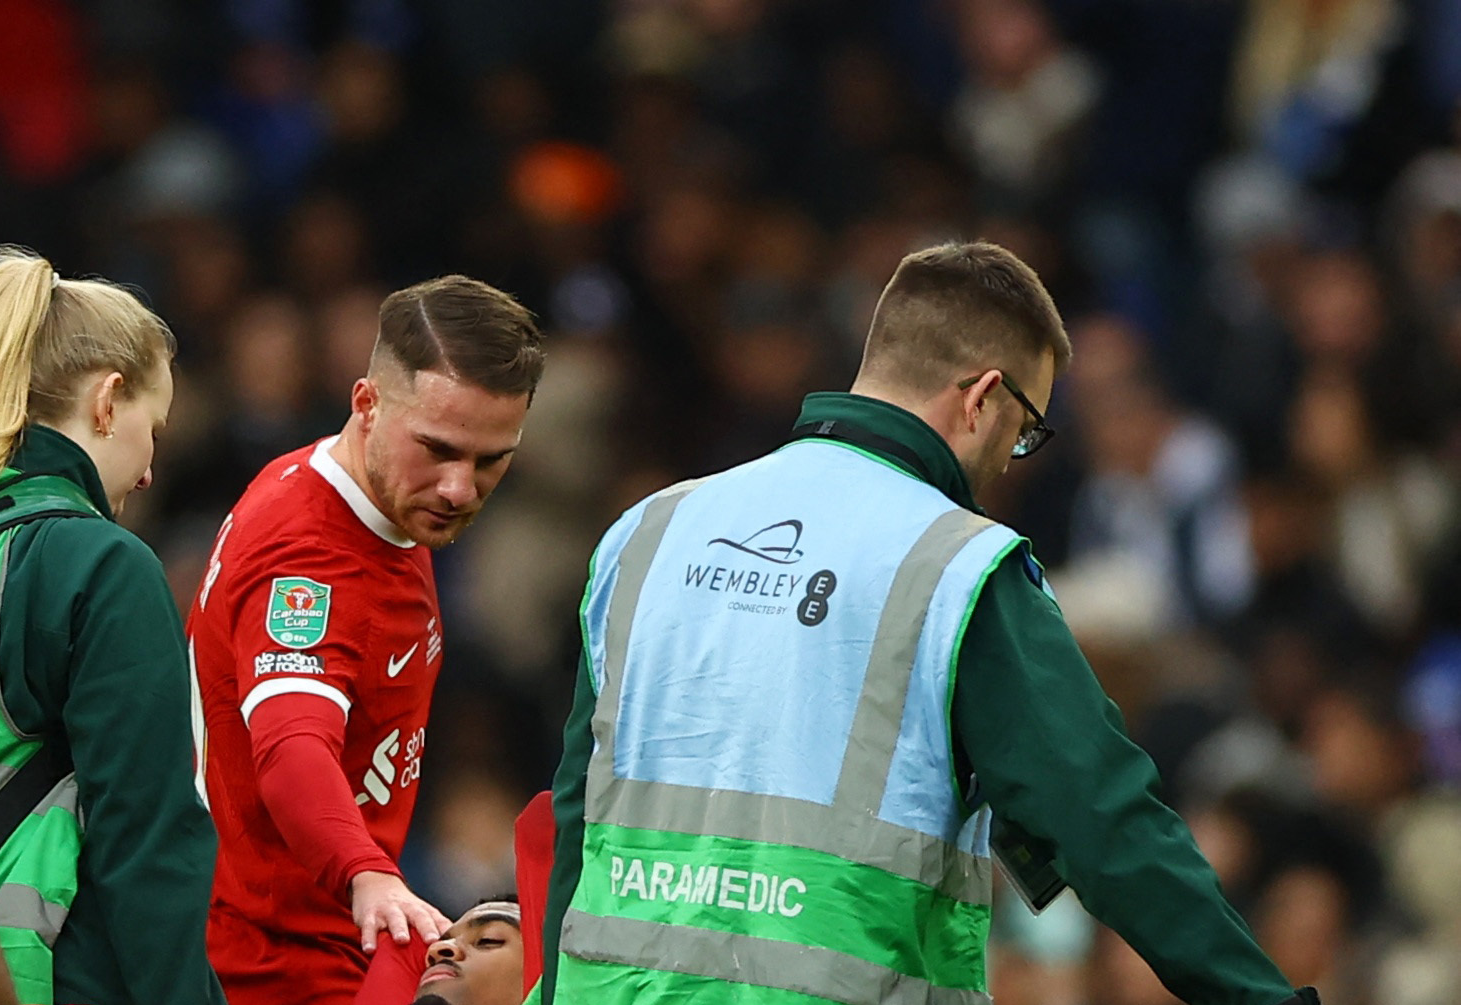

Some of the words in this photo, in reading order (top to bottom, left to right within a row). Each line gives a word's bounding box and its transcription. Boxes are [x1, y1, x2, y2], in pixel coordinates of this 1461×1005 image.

[685, 563, 803, 598] WEMBLEY
[272, 609, 324, 619] Carabao
[727, 601, 775, 615] CONNECTED
[775, 604, 788, 615] BY
[284, 617, 309, 628] Cup
[255, 652, 276, 665] No
[277, 652, 318, 666] room
[610, 856, 807, 918] PARAMEDIC
